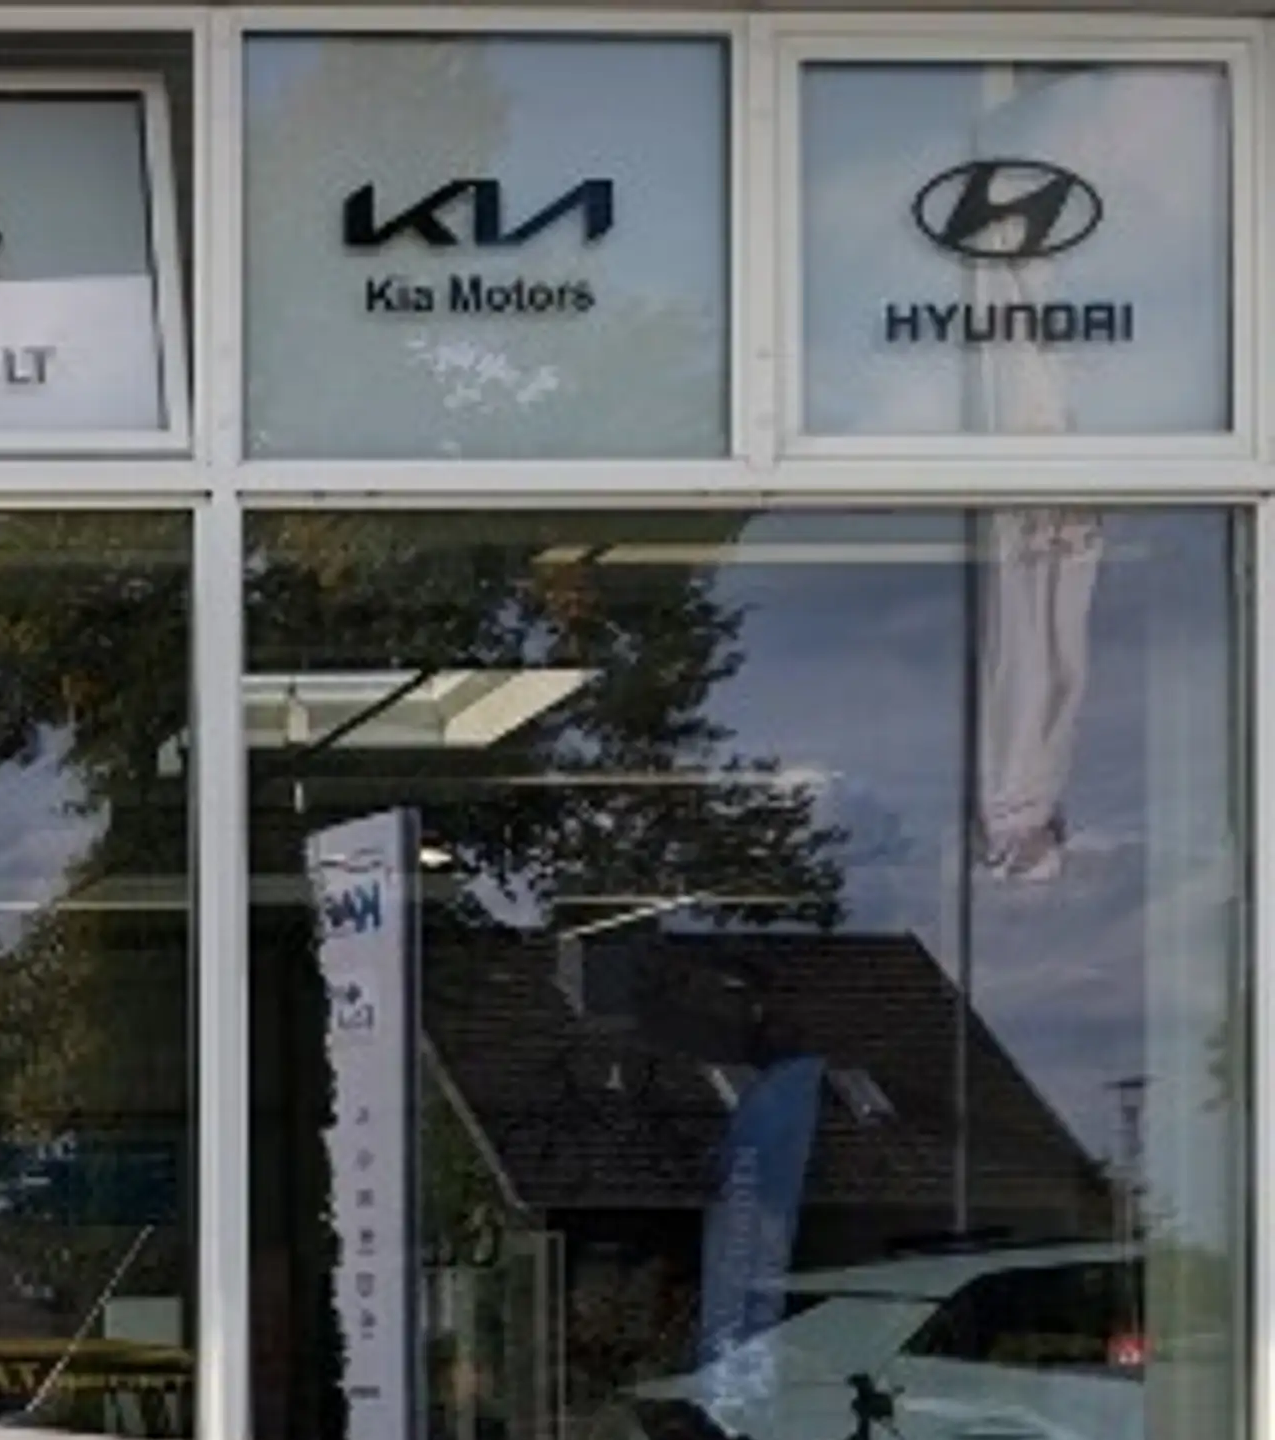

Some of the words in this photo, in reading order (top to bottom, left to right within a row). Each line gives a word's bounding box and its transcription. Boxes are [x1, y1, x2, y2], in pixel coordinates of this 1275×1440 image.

[343, 178, 614, 247] KIA
[365, 275, 435, 312] Kia
[448, 273, 596, 312] Motors
[885, 302, 1134, 342] HYUNDAI
